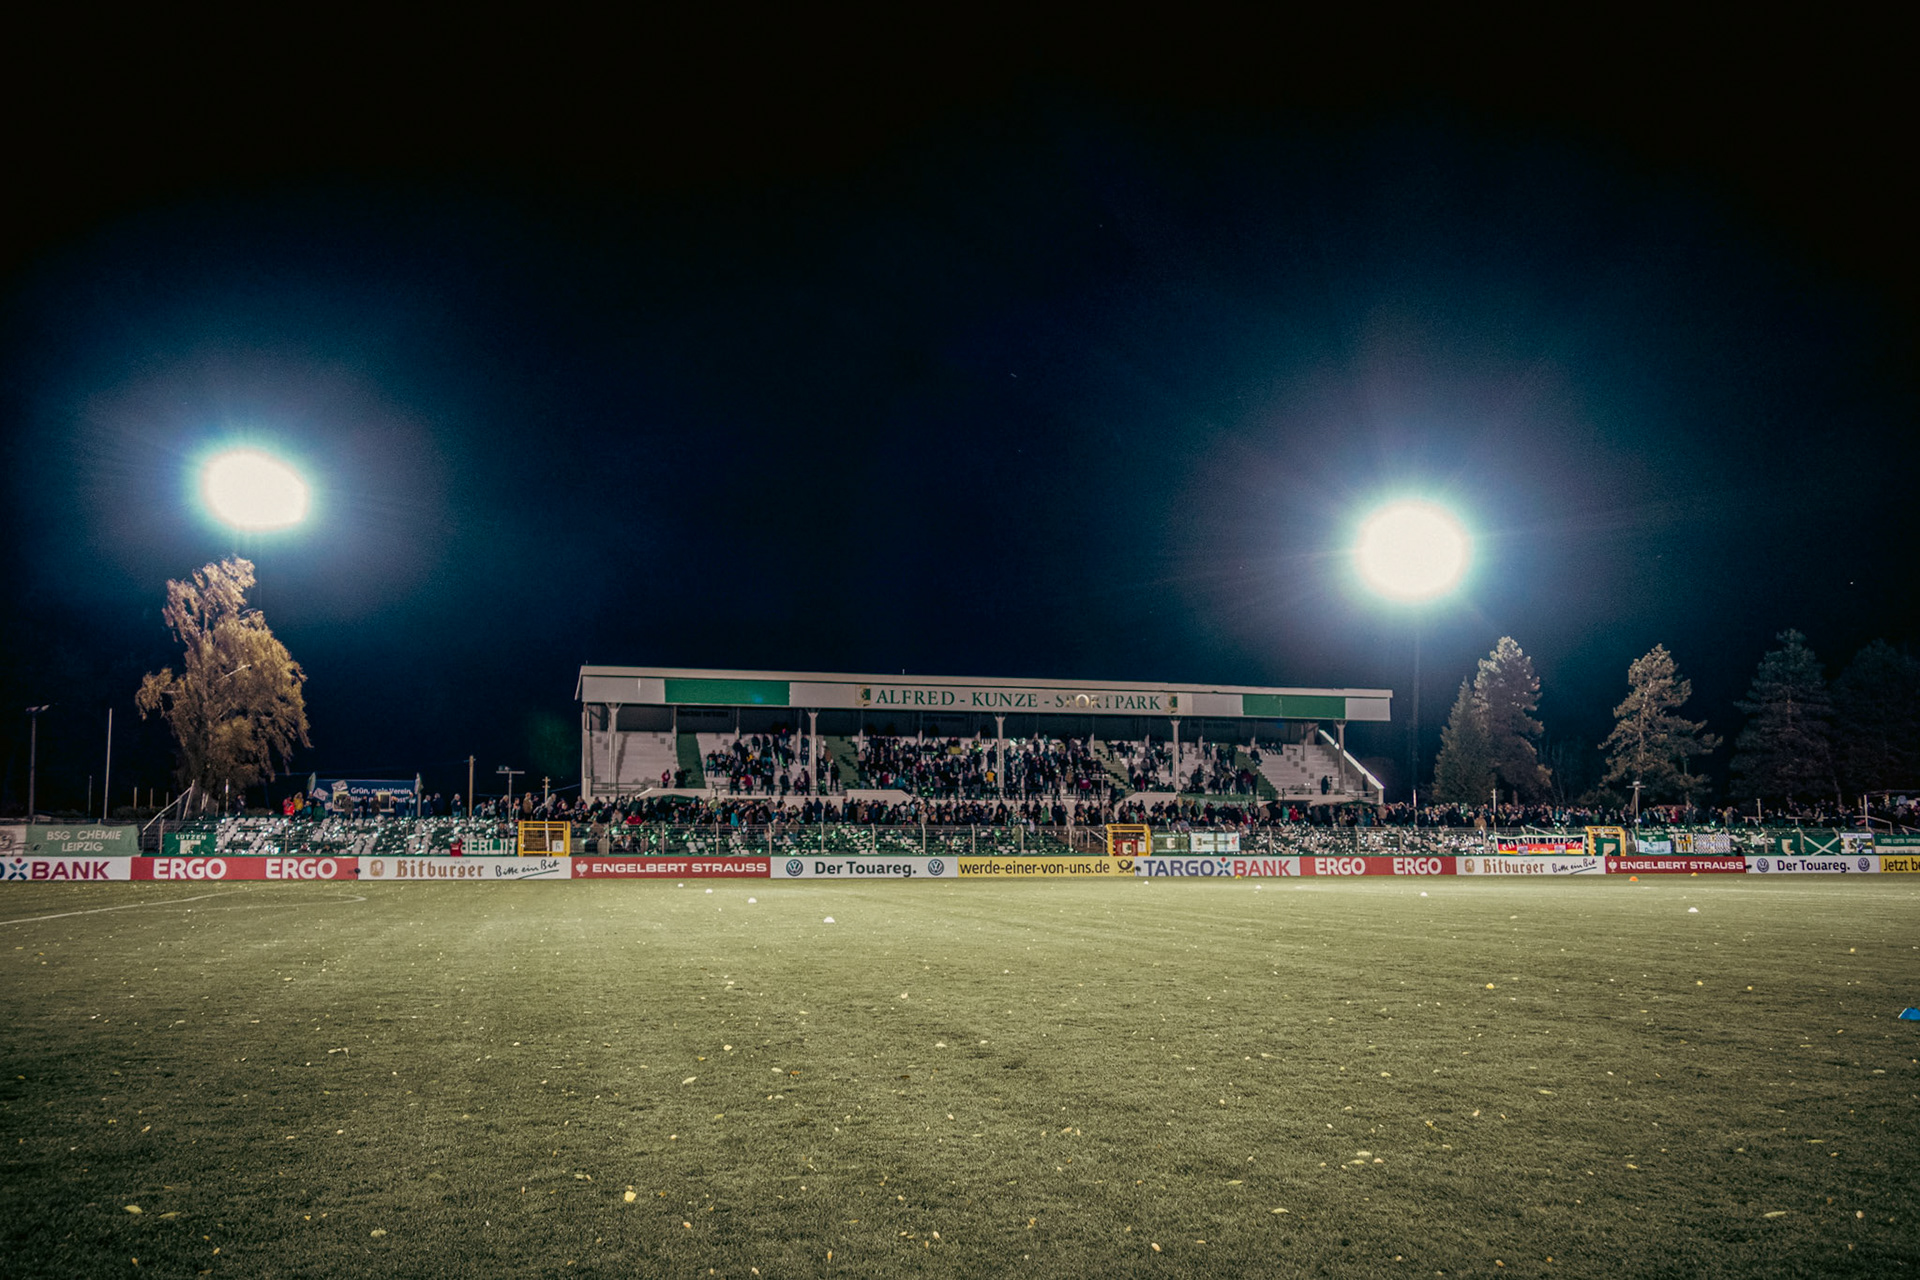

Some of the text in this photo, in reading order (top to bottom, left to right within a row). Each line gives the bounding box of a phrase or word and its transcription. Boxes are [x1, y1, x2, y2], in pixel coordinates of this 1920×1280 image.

[876, 689, 955, 705] ALFRED
[971, 691, 1038, 707] KUNZE
[1055, 693, 1161, 710] SPORTPARK
[46, 829, 122, 841] BSG CHEMIE
[61, 841, 104, 852] LEIPZIG
[32, 861, 110, 880] BANK
[153, 858, 338, 880] ERGO ERGO
[396, 859, 560, 878] Bitburger Bitte ein Bit
[592, 862, 767, 873] ENGELBERT STRAUSS
[815, 861, 843, 874] Der
[849, 861, 917, 878] Touareg.
[960, 860, 1110, 875] werde-einer-von-uns.de
[1315, 857, 1442, 875] ERGO ERGO
[1483, 858, 1545, 874] Bitburger
[1620, 860, 1743, 870] ENGELBERT STRAUSS
[1777, 859, 1797, 871] Der
[1801, 859, 1850, 873] Touareg.
[1883, 858, 1909, 871] Jetzt
